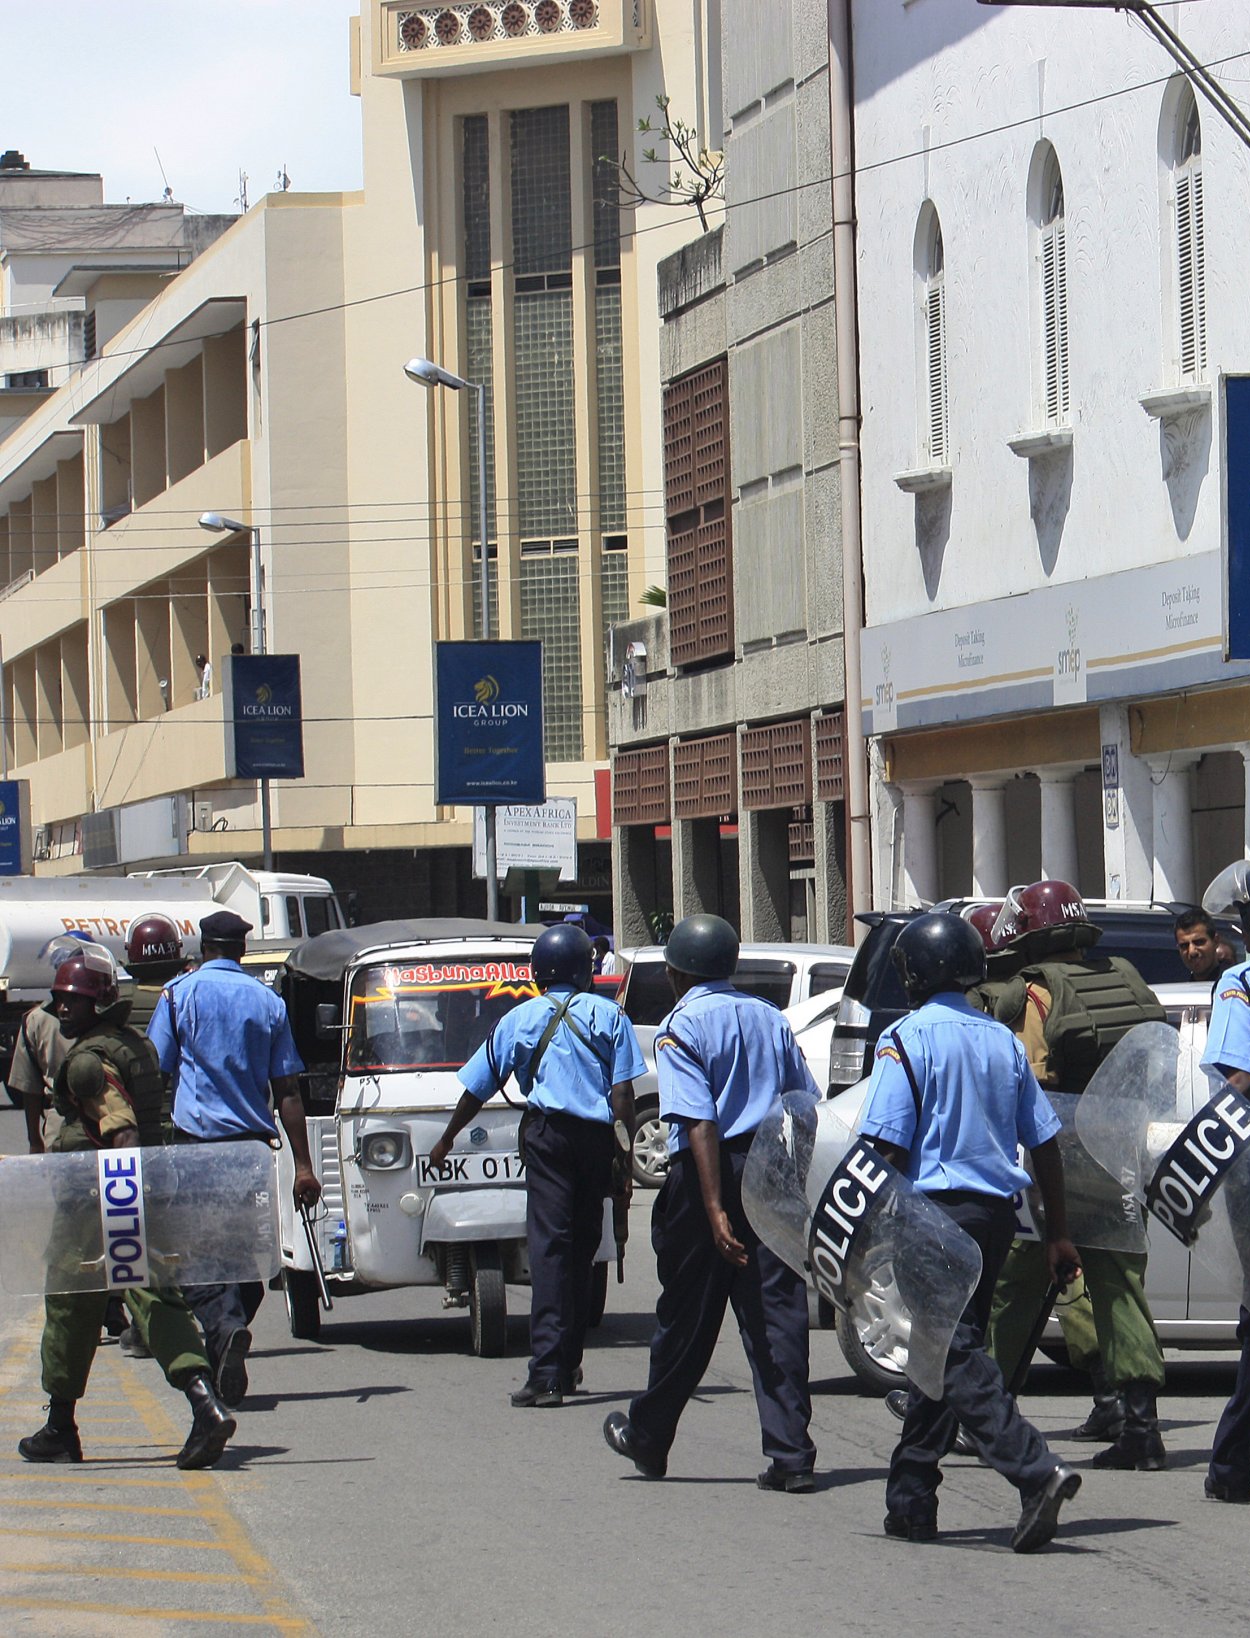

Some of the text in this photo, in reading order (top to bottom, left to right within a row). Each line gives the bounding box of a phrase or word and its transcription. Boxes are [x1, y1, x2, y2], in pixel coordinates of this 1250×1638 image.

[1058, 648, 1080, 682] smep
[243, 704, 292, 716] ICEA LION
[453, 704, 528, 718] ICEA LION
[473, 719, 508, 727] GROUP
[1061, 902, 1088, 918] MSA
[142, 943, 166, 956] MSA
[1121, 1192, 1138, 1224] MSA
[103, 1156, 144, 1284] POLICE
[813, 1149, 888, 1313] POLICE
